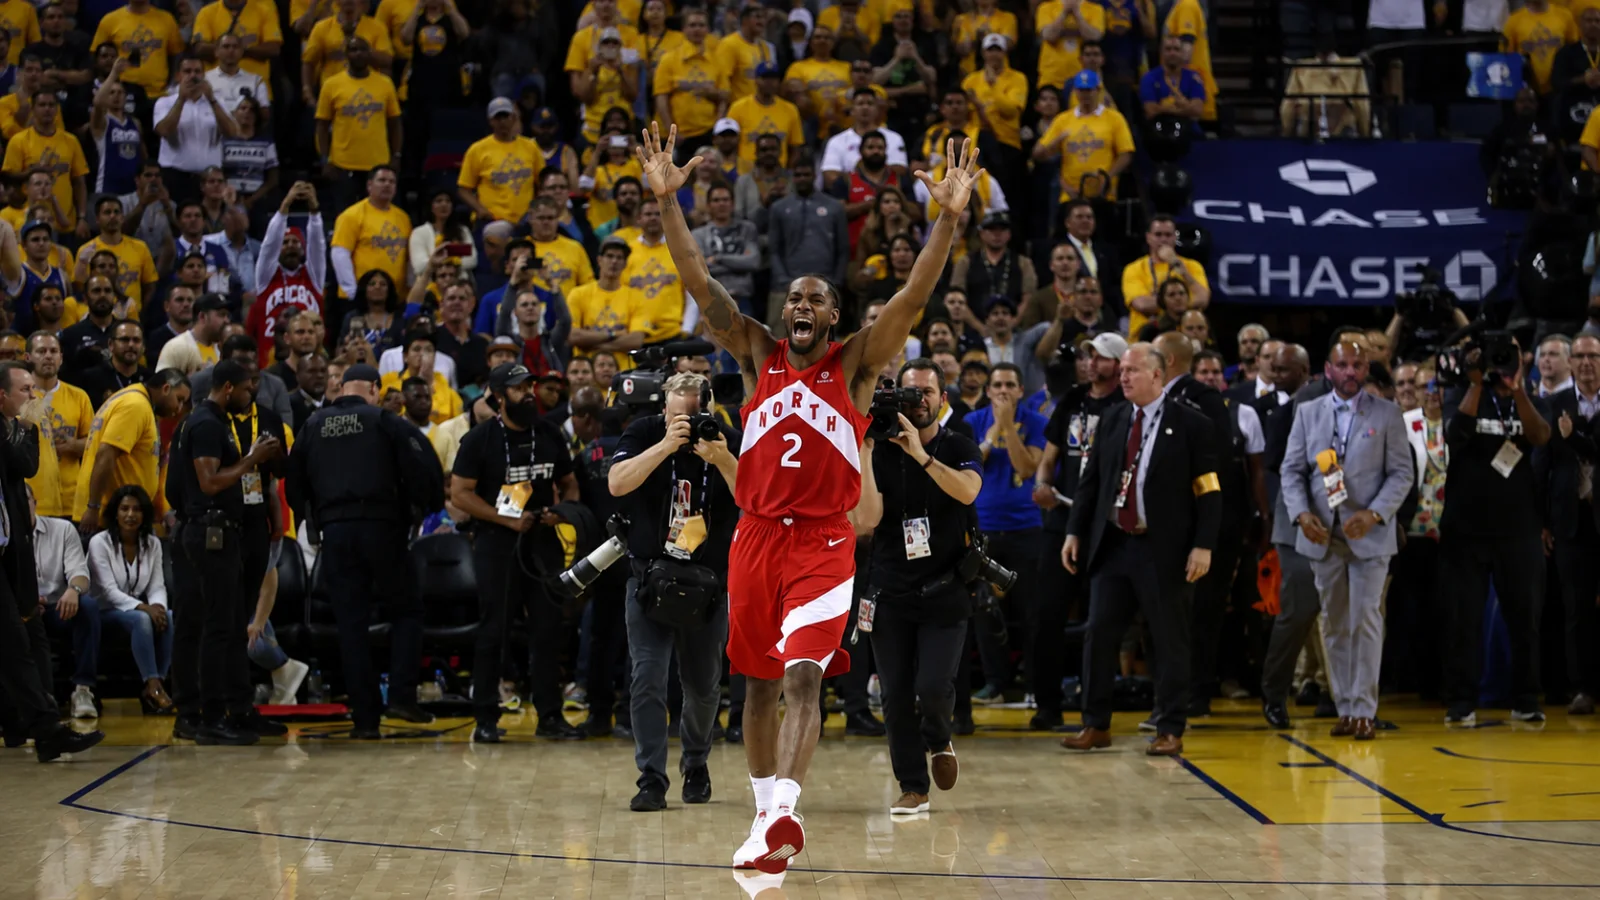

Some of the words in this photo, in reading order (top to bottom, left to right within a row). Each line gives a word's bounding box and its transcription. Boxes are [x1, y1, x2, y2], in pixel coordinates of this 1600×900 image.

[1192, 200, 1488, 228] CHASE
[1218, 253, 1430, 299] CHASE
[759, 391, 837, 432] NORTH
[780, 432, 803, 468] 2
